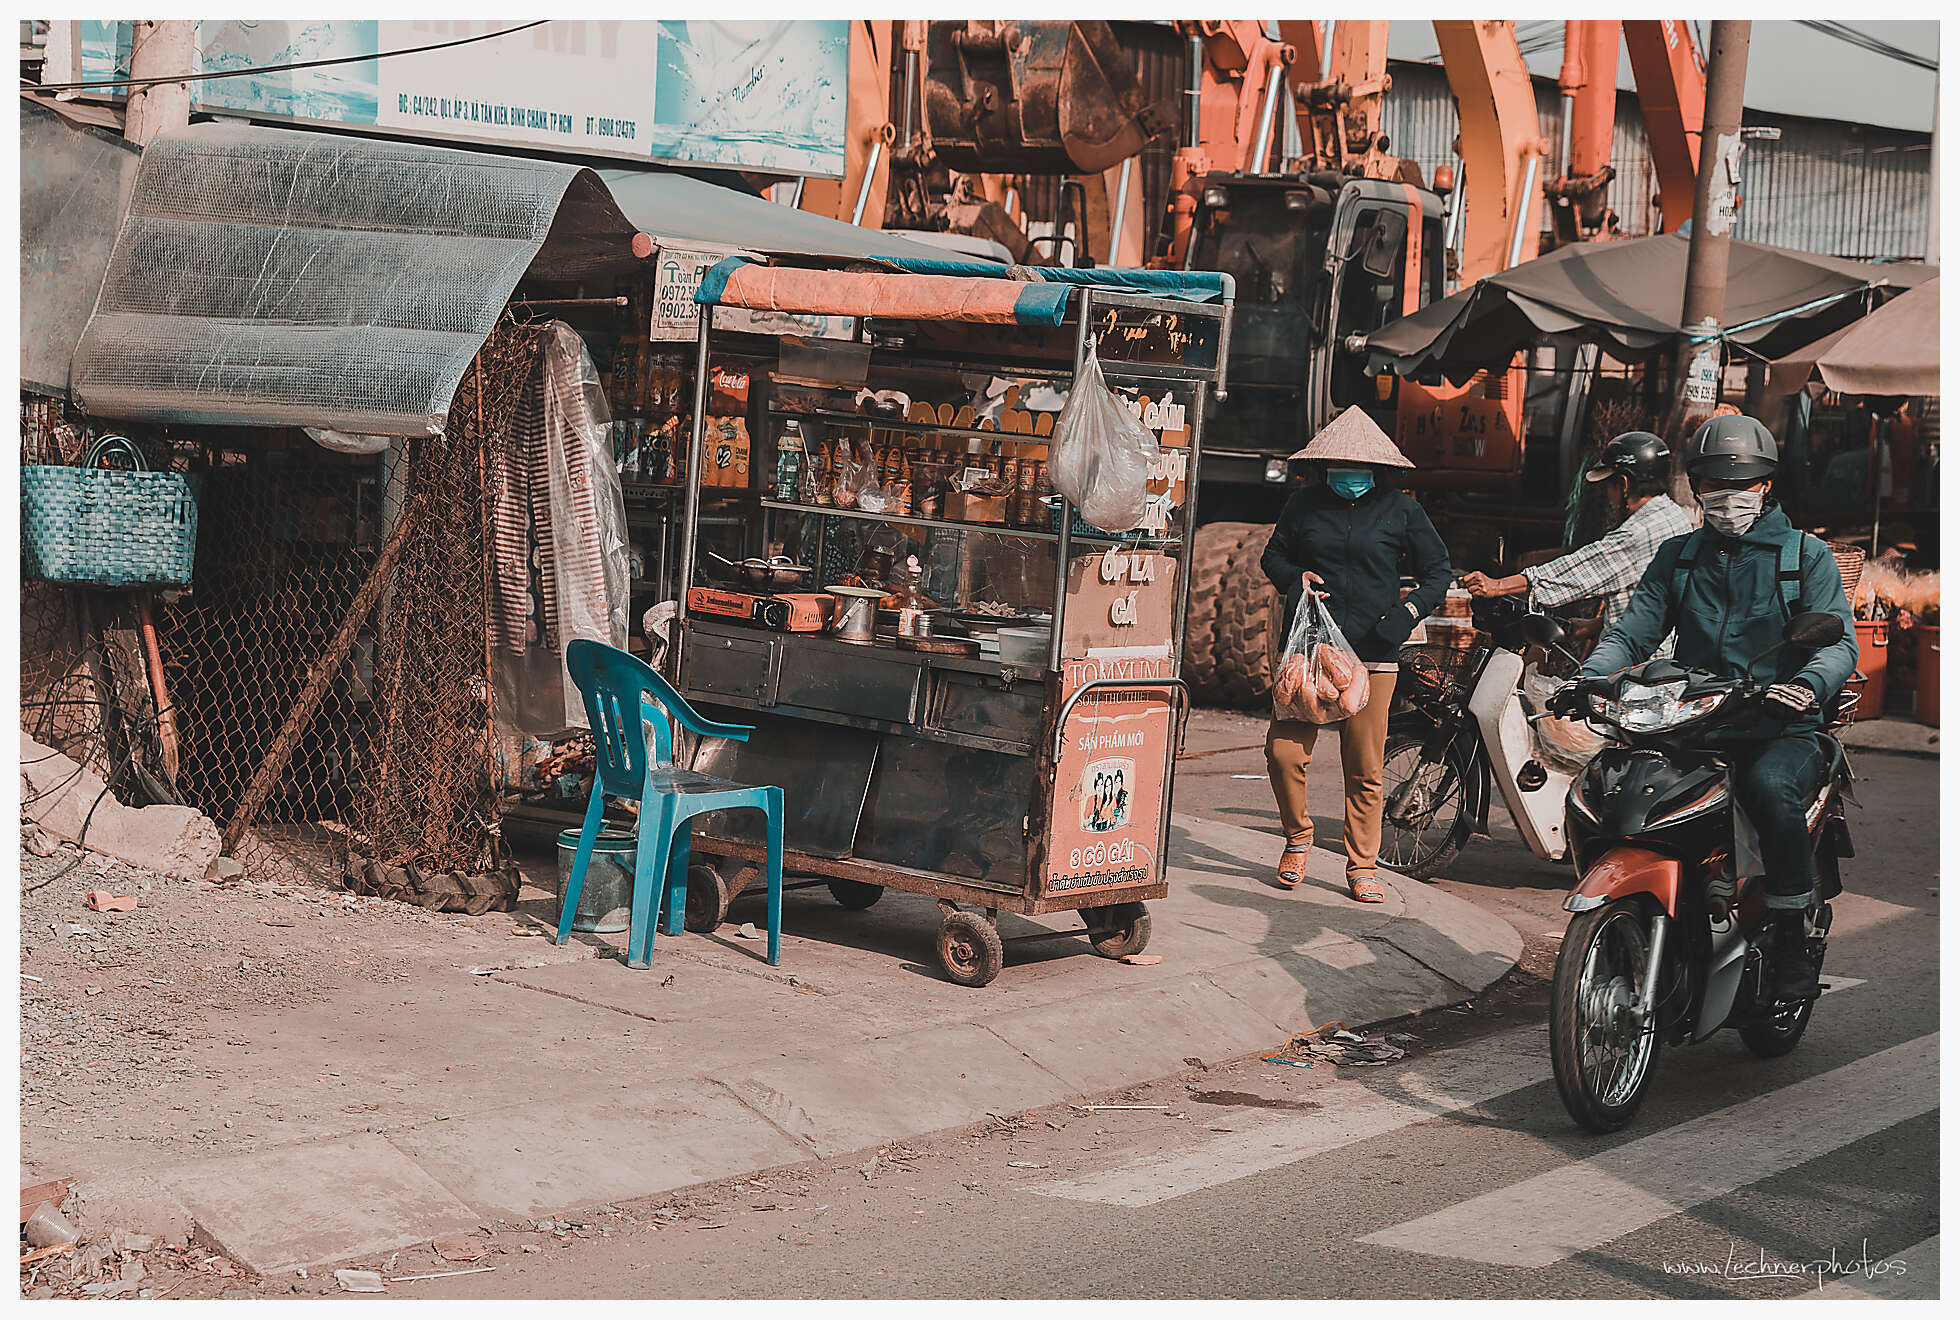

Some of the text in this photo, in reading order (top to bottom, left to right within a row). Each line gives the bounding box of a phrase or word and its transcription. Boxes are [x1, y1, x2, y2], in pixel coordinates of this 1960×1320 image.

[716, 447, 731, 468] C2
[1070, 838, 1135, 869] 3 CÔ GÁI
